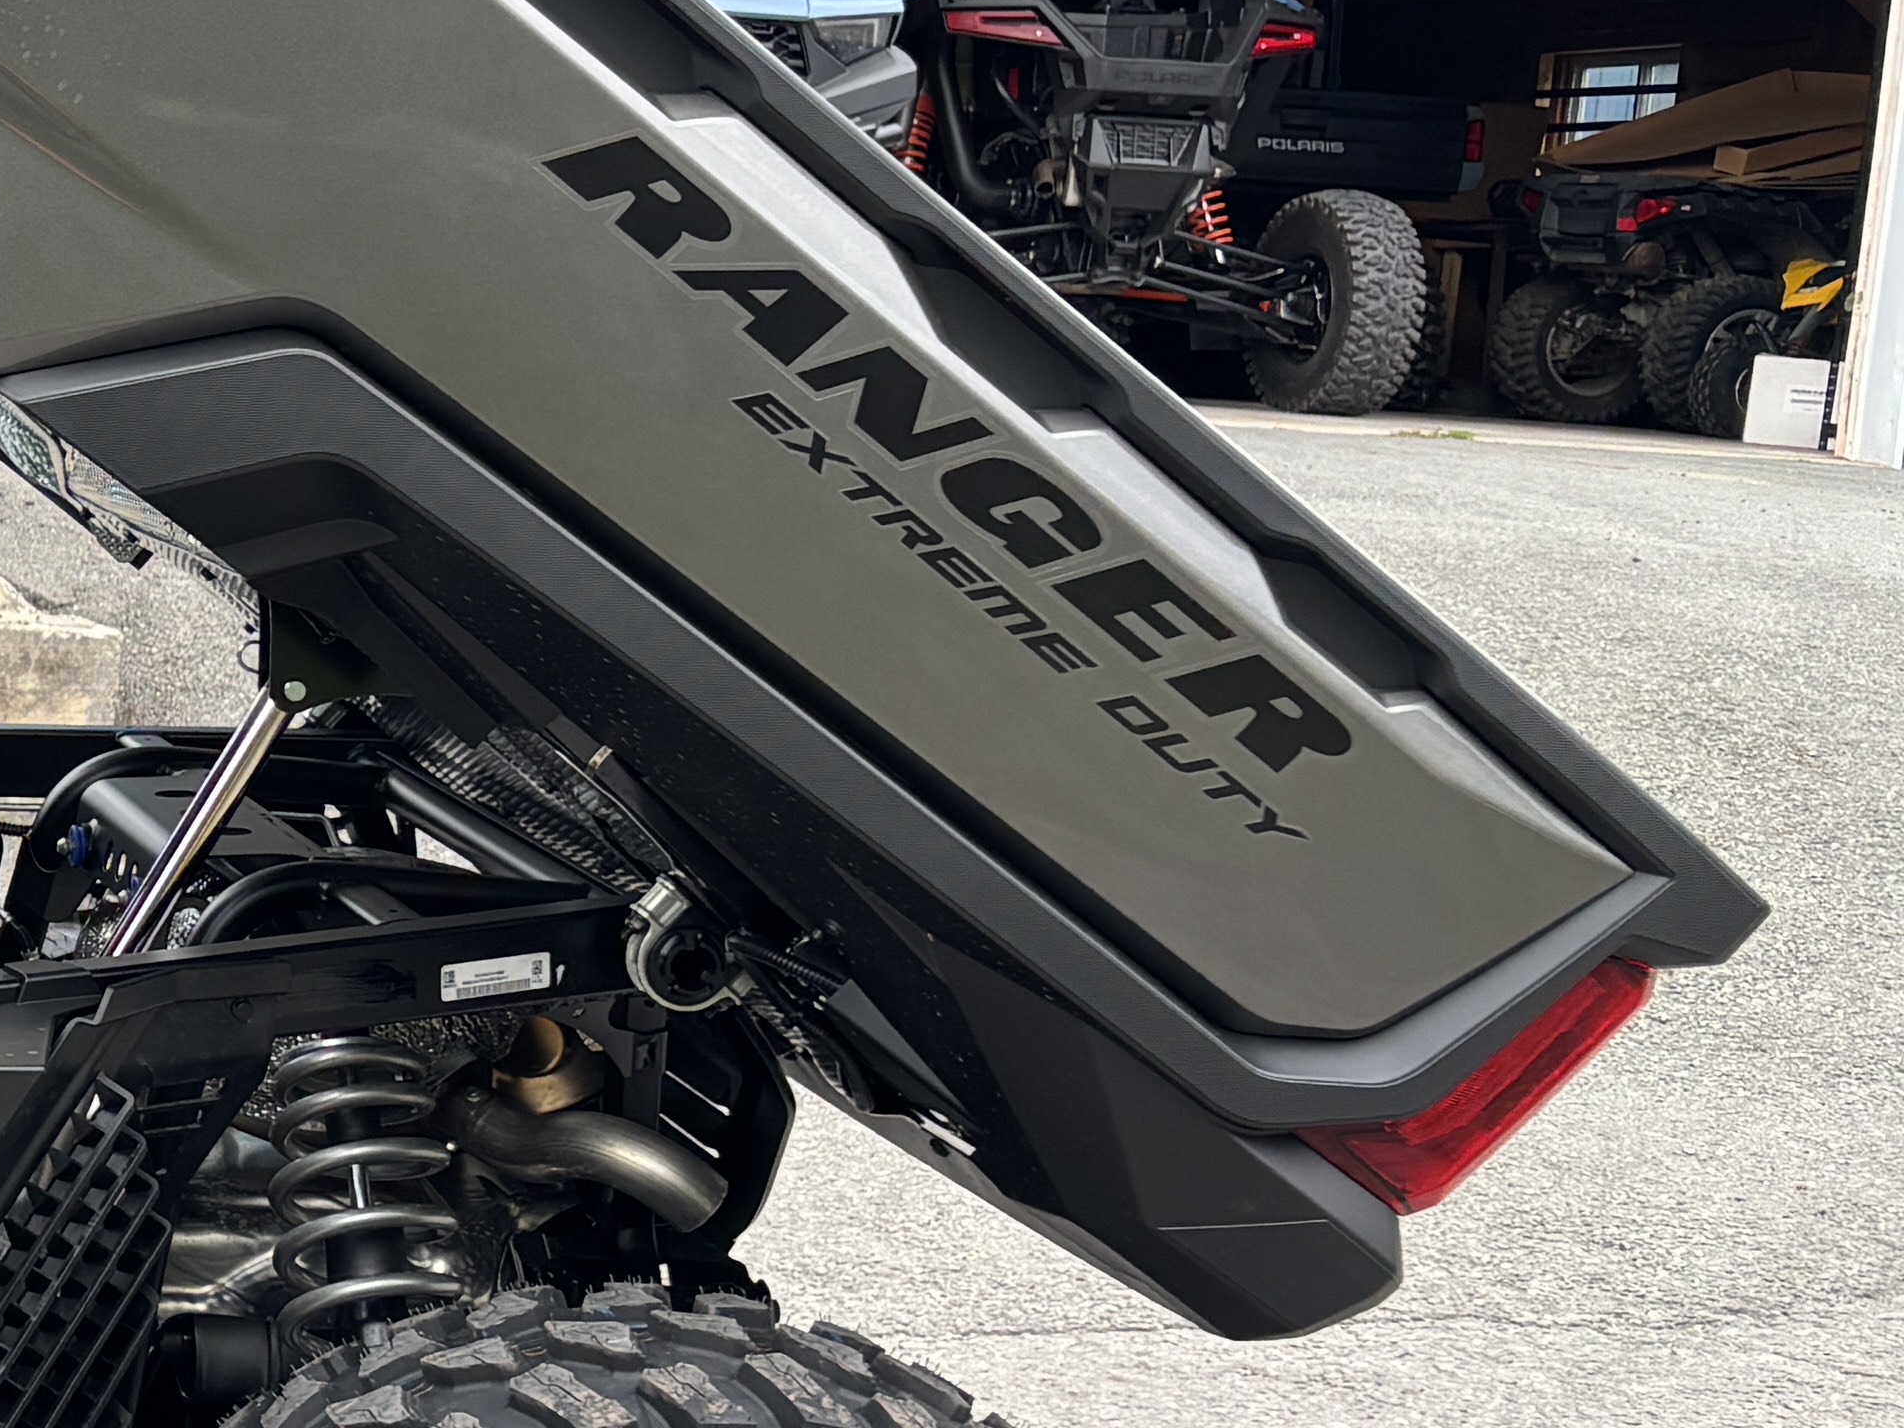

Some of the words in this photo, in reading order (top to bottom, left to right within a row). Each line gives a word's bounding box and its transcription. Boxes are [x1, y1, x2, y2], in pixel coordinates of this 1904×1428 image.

[1257, 137, 1344, 153] POLARIS
[540, 136, 1352, 773] RANGER
[731, 392, 1097, 675] EXTREME
[1096, 694, 1309, 840] DUTY
